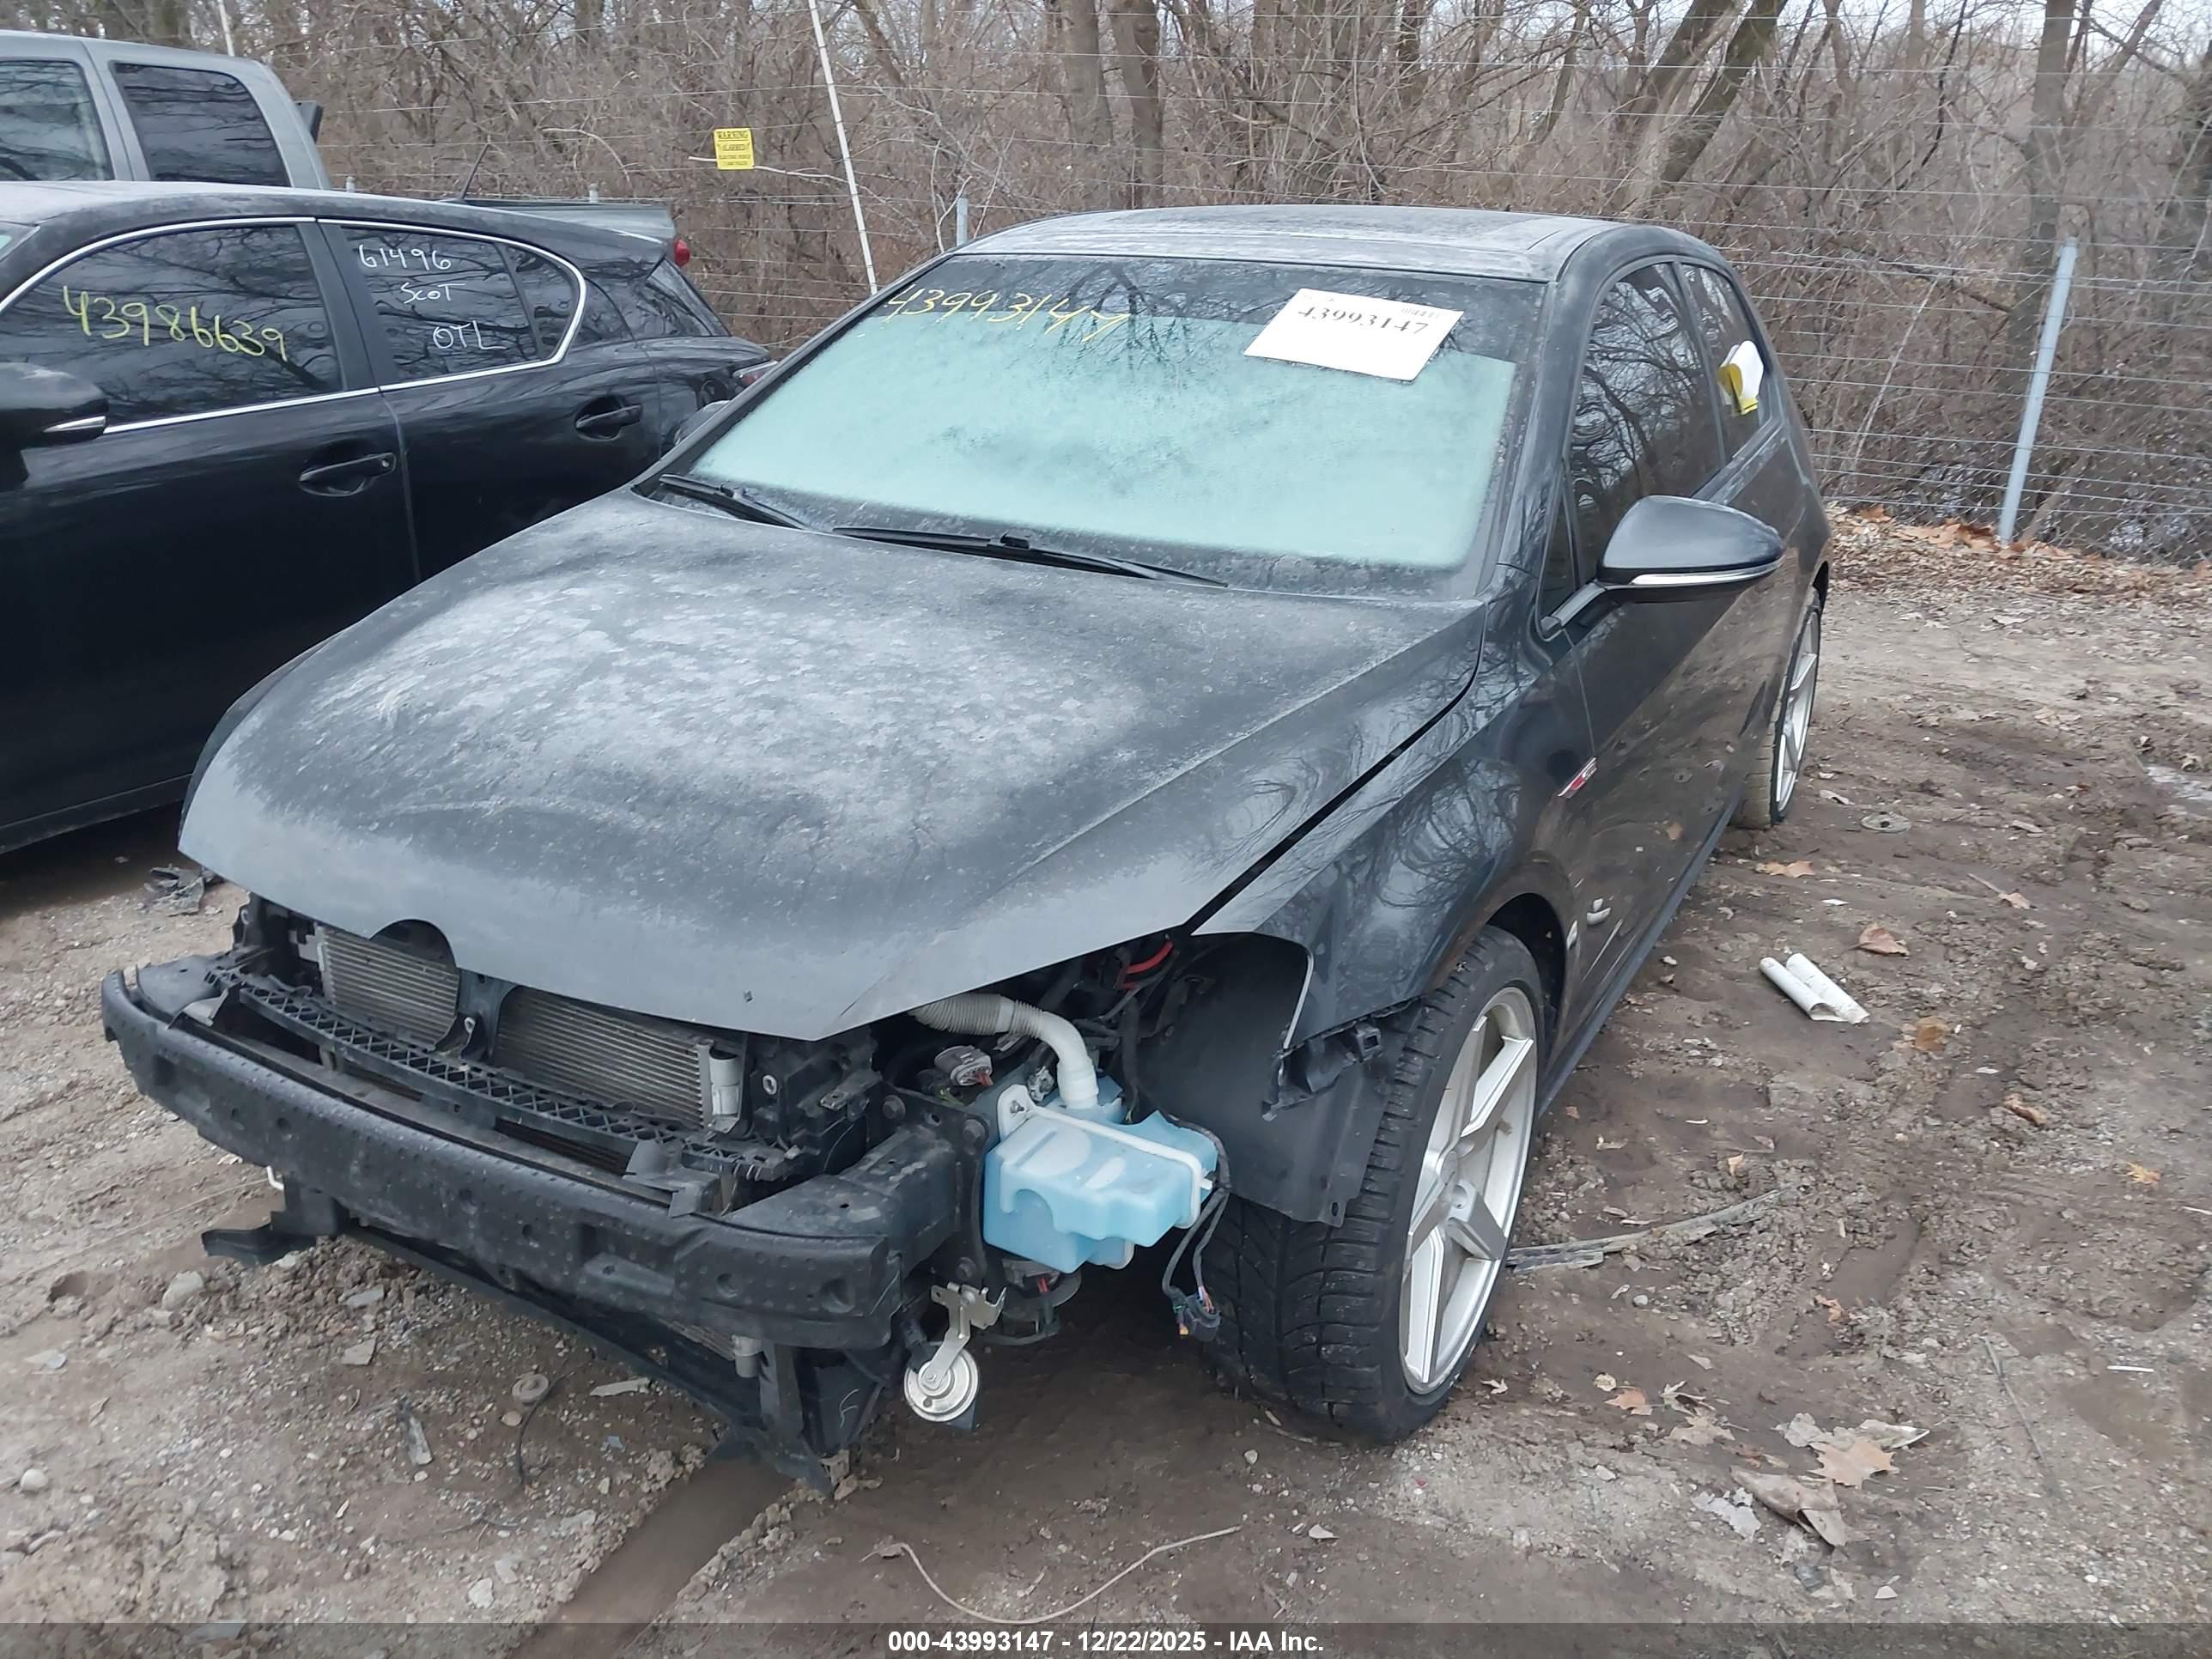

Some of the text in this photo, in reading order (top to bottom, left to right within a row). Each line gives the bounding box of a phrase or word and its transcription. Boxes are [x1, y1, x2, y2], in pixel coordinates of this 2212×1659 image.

[358, 244, 452, 271] 61496
[64, 285, 288, 362] 43986639
[433, 319, 508, 349] OTL
[1297, 306, 1430, 335] 43993147
